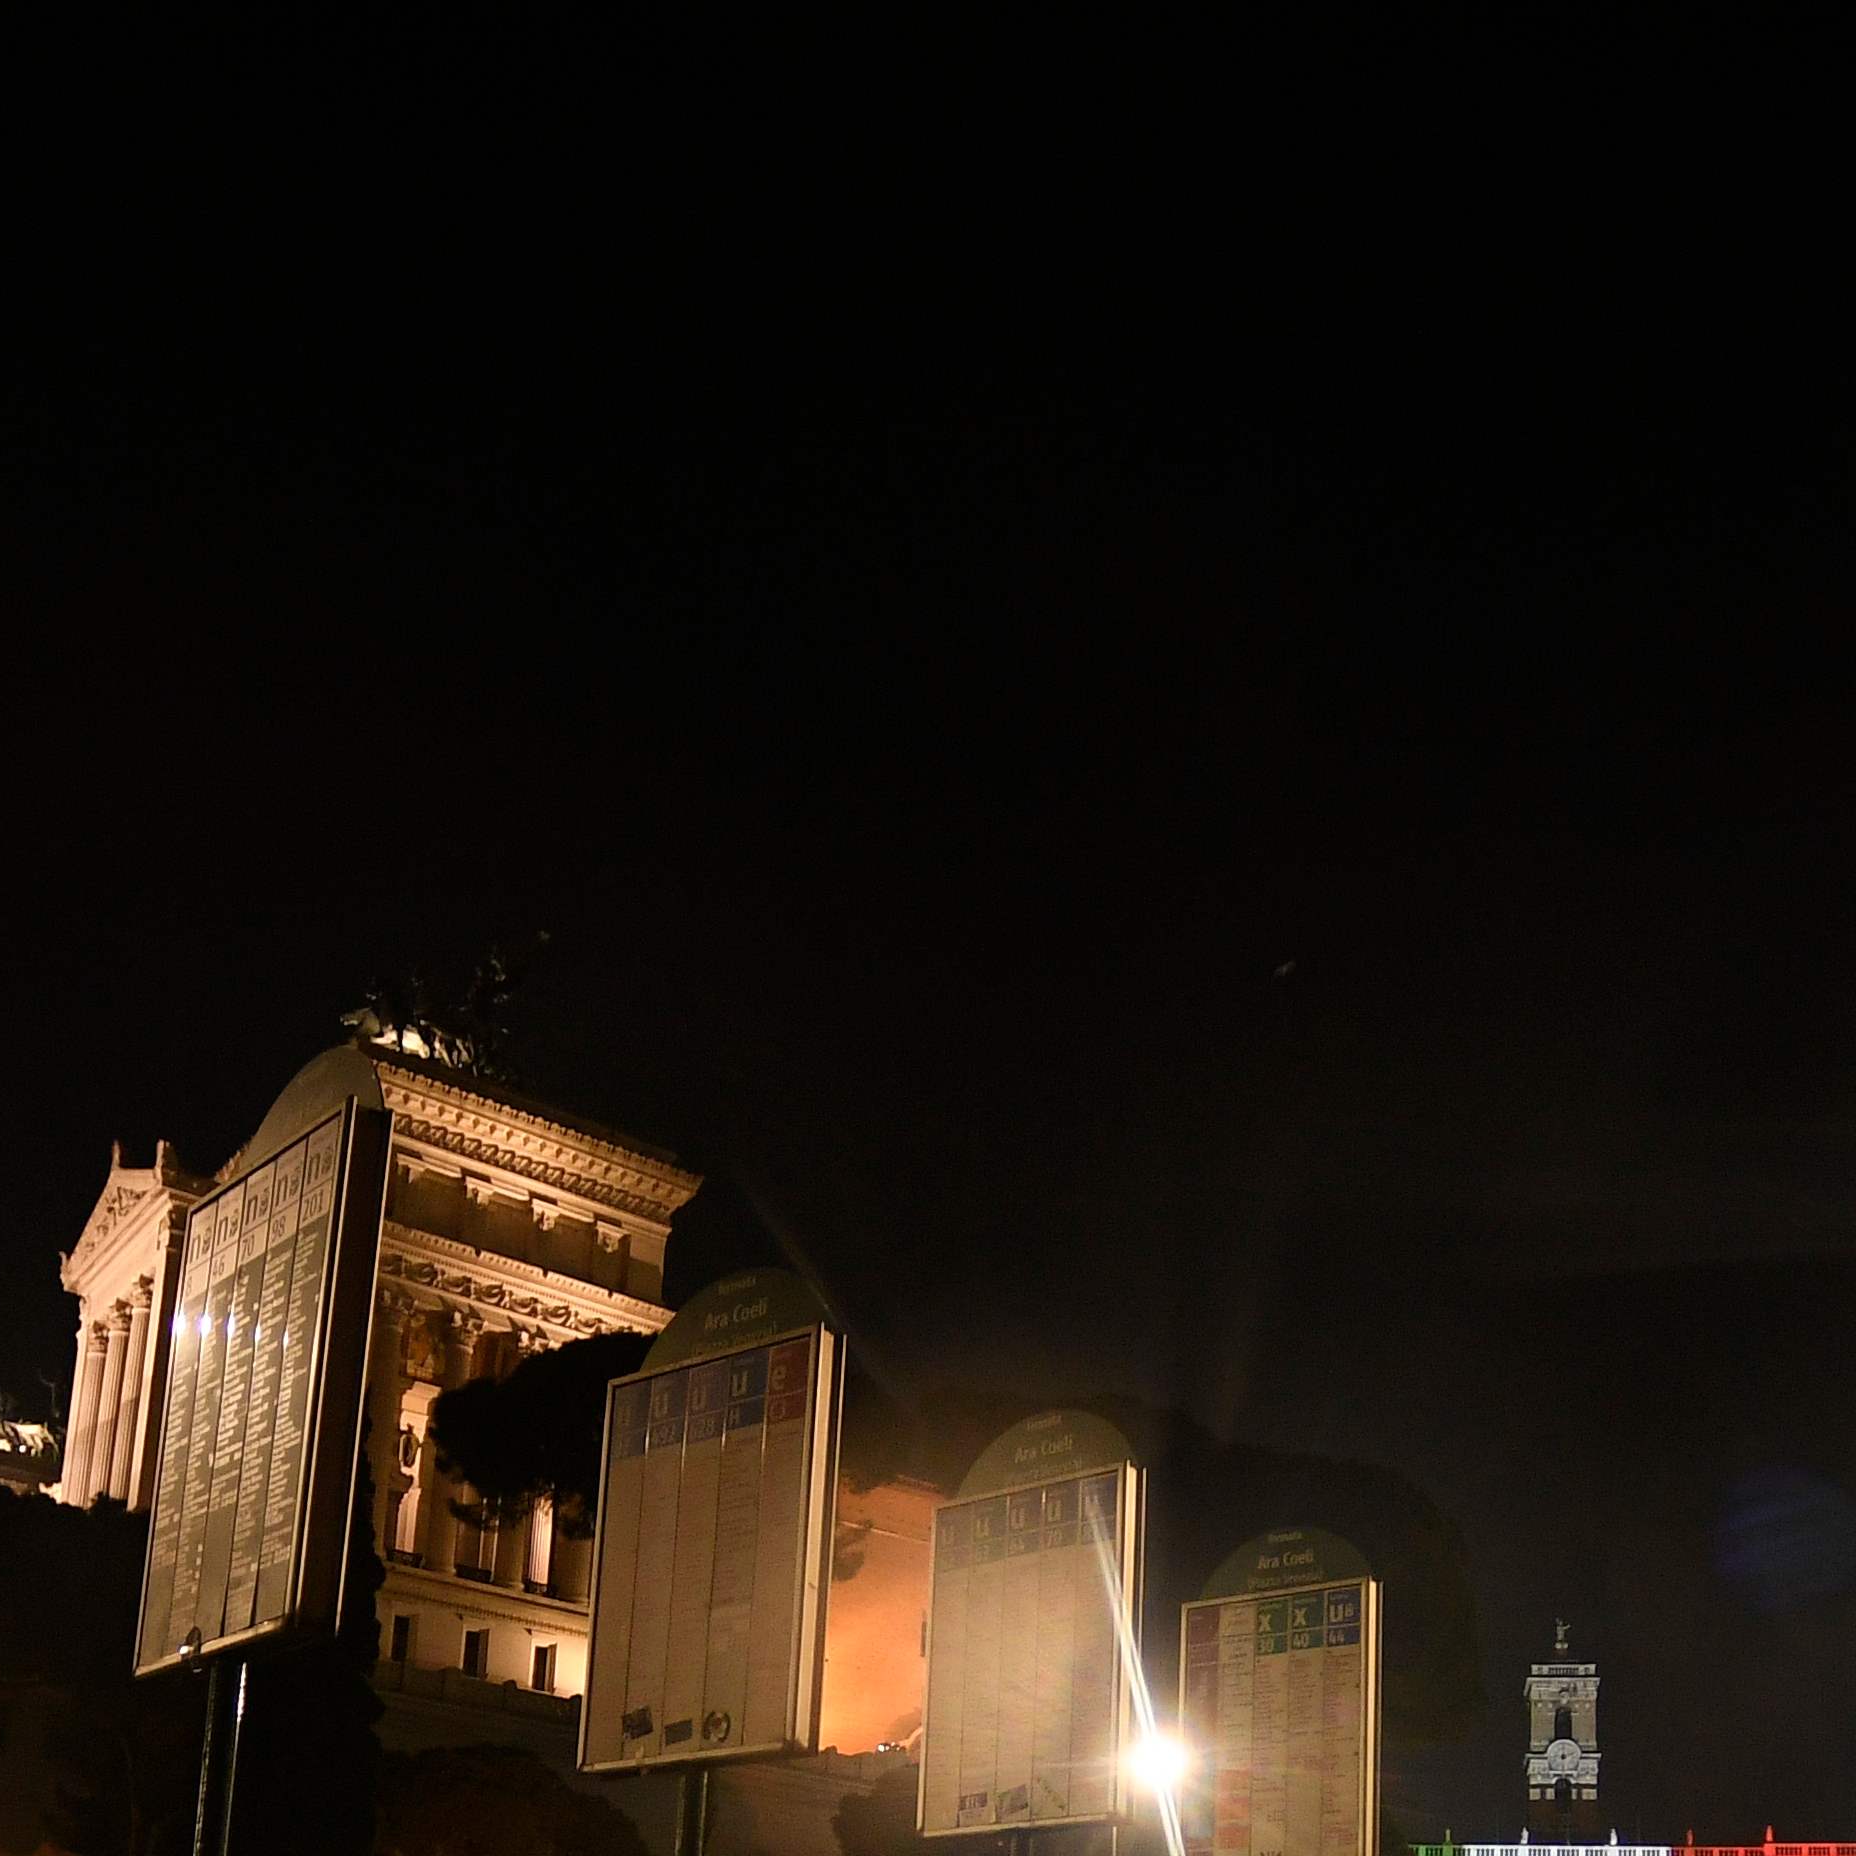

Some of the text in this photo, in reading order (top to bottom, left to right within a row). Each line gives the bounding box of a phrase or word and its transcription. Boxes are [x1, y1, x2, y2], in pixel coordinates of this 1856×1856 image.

[302, 1189, 324, 1222] 201
[271, 1215, 286, 1243] 98
[240, 1234, 255, 1262] 70
[704, 1296, 769, 1331] Ara Coeli
[1014, 1433, 1073, 1464] Ara Coeli
[1257, 1548, 1314, 1570] Ara Coeli
[1257, 1637, 1274, 1653] 30
[1293, 1632, 1309, 1648] 40
[1329, 1629, 1344, 1644] 44
